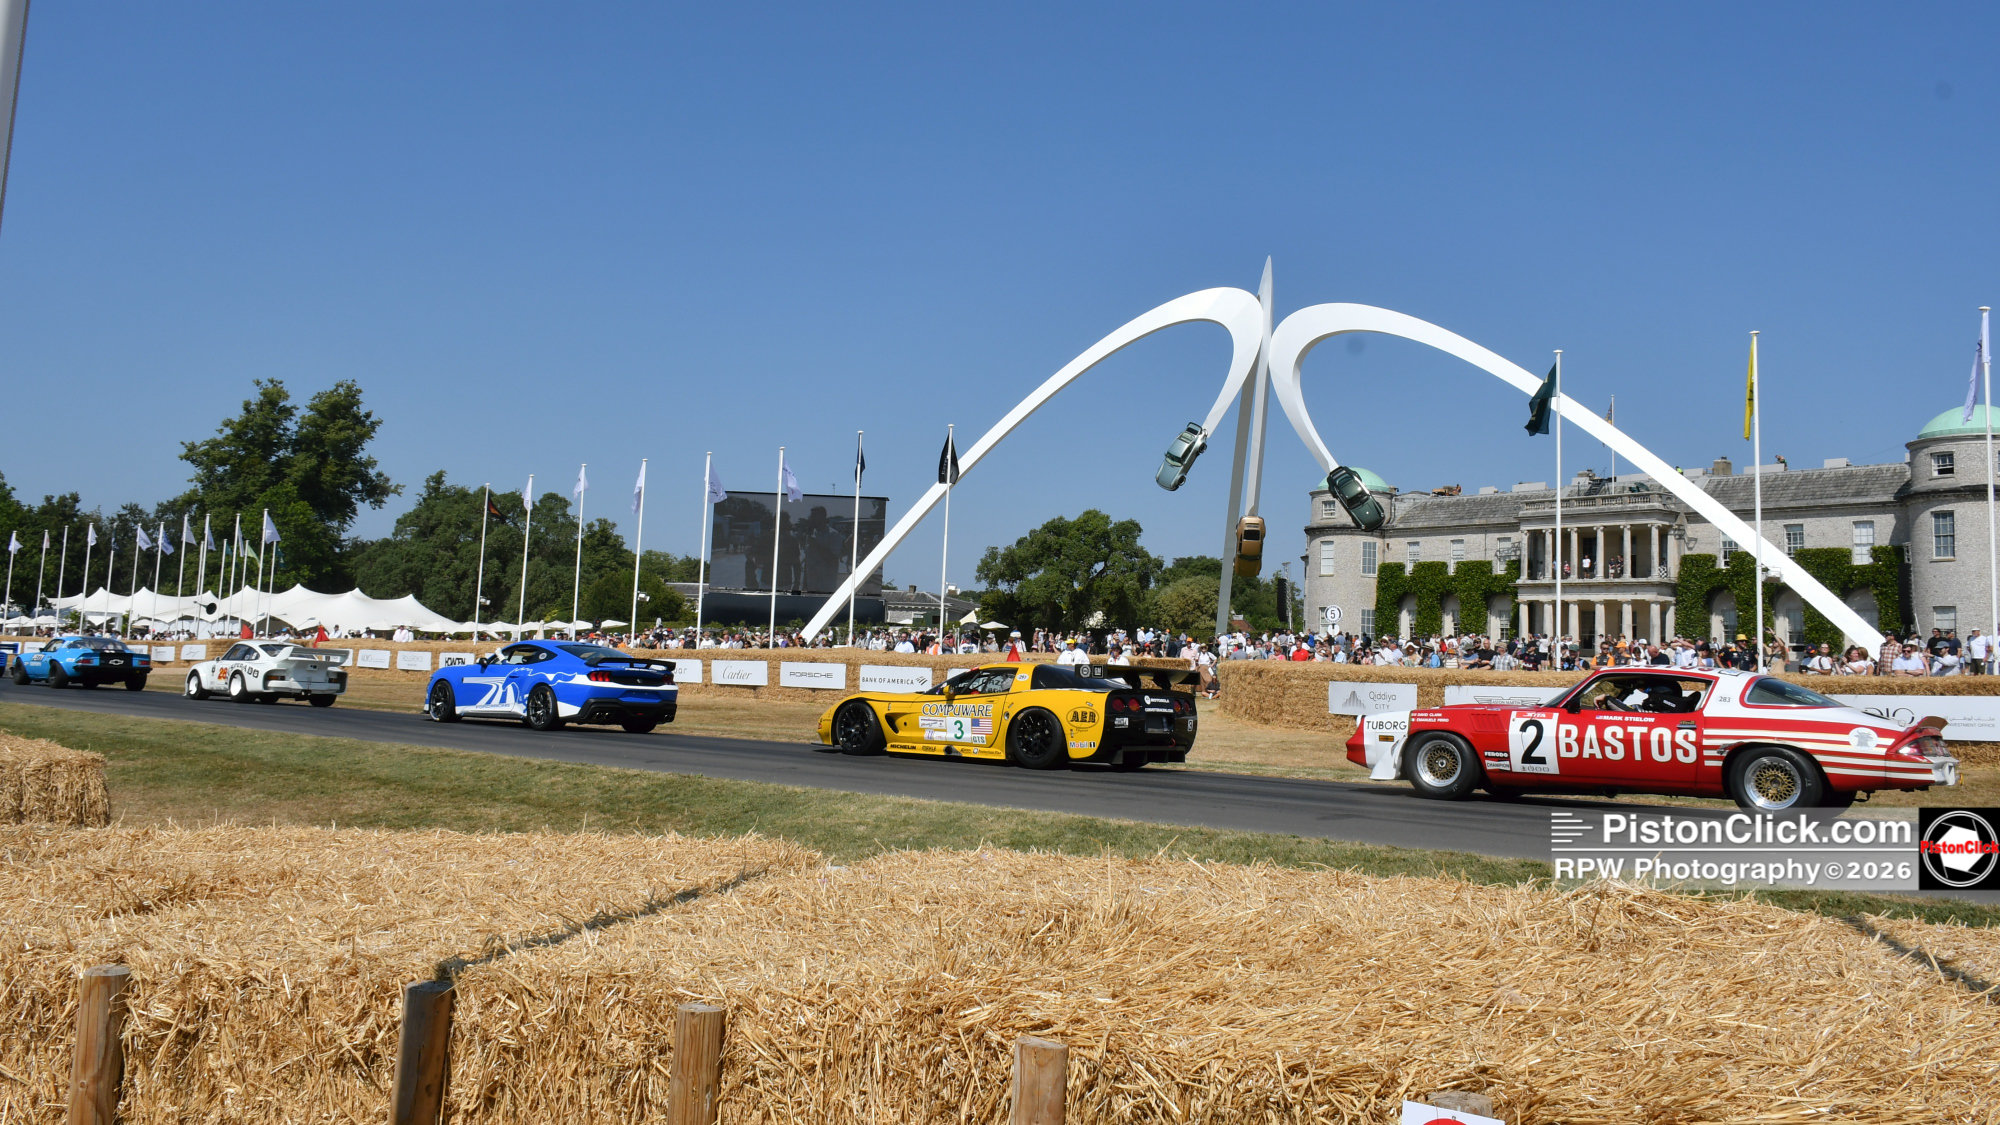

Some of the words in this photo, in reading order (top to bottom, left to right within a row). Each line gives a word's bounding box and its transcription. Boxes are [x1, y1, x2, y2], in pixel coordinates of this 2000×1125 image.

[1330, 609, 1336, 619] 5
[722, 665, 752, 680] Cartier
[789, 671, 834, 679] PORSCHE
[861, 676, 878, 684] BANK
[886, 678, 915, 686] AMERICA
[1369, 691, 1397, 702] Qiddiya
[1718, 695, 1731, 703] 283
[921, 702, 993, 718] COMPUWARE
[953, 720, 965, 740] 3
[1366, 720, 1408, 731] TUBORG
[972, 735, 986, 744] GTS
[1519, 719, 1547, 765] 2
[1558, 723, 1698, 764] BASTOS
